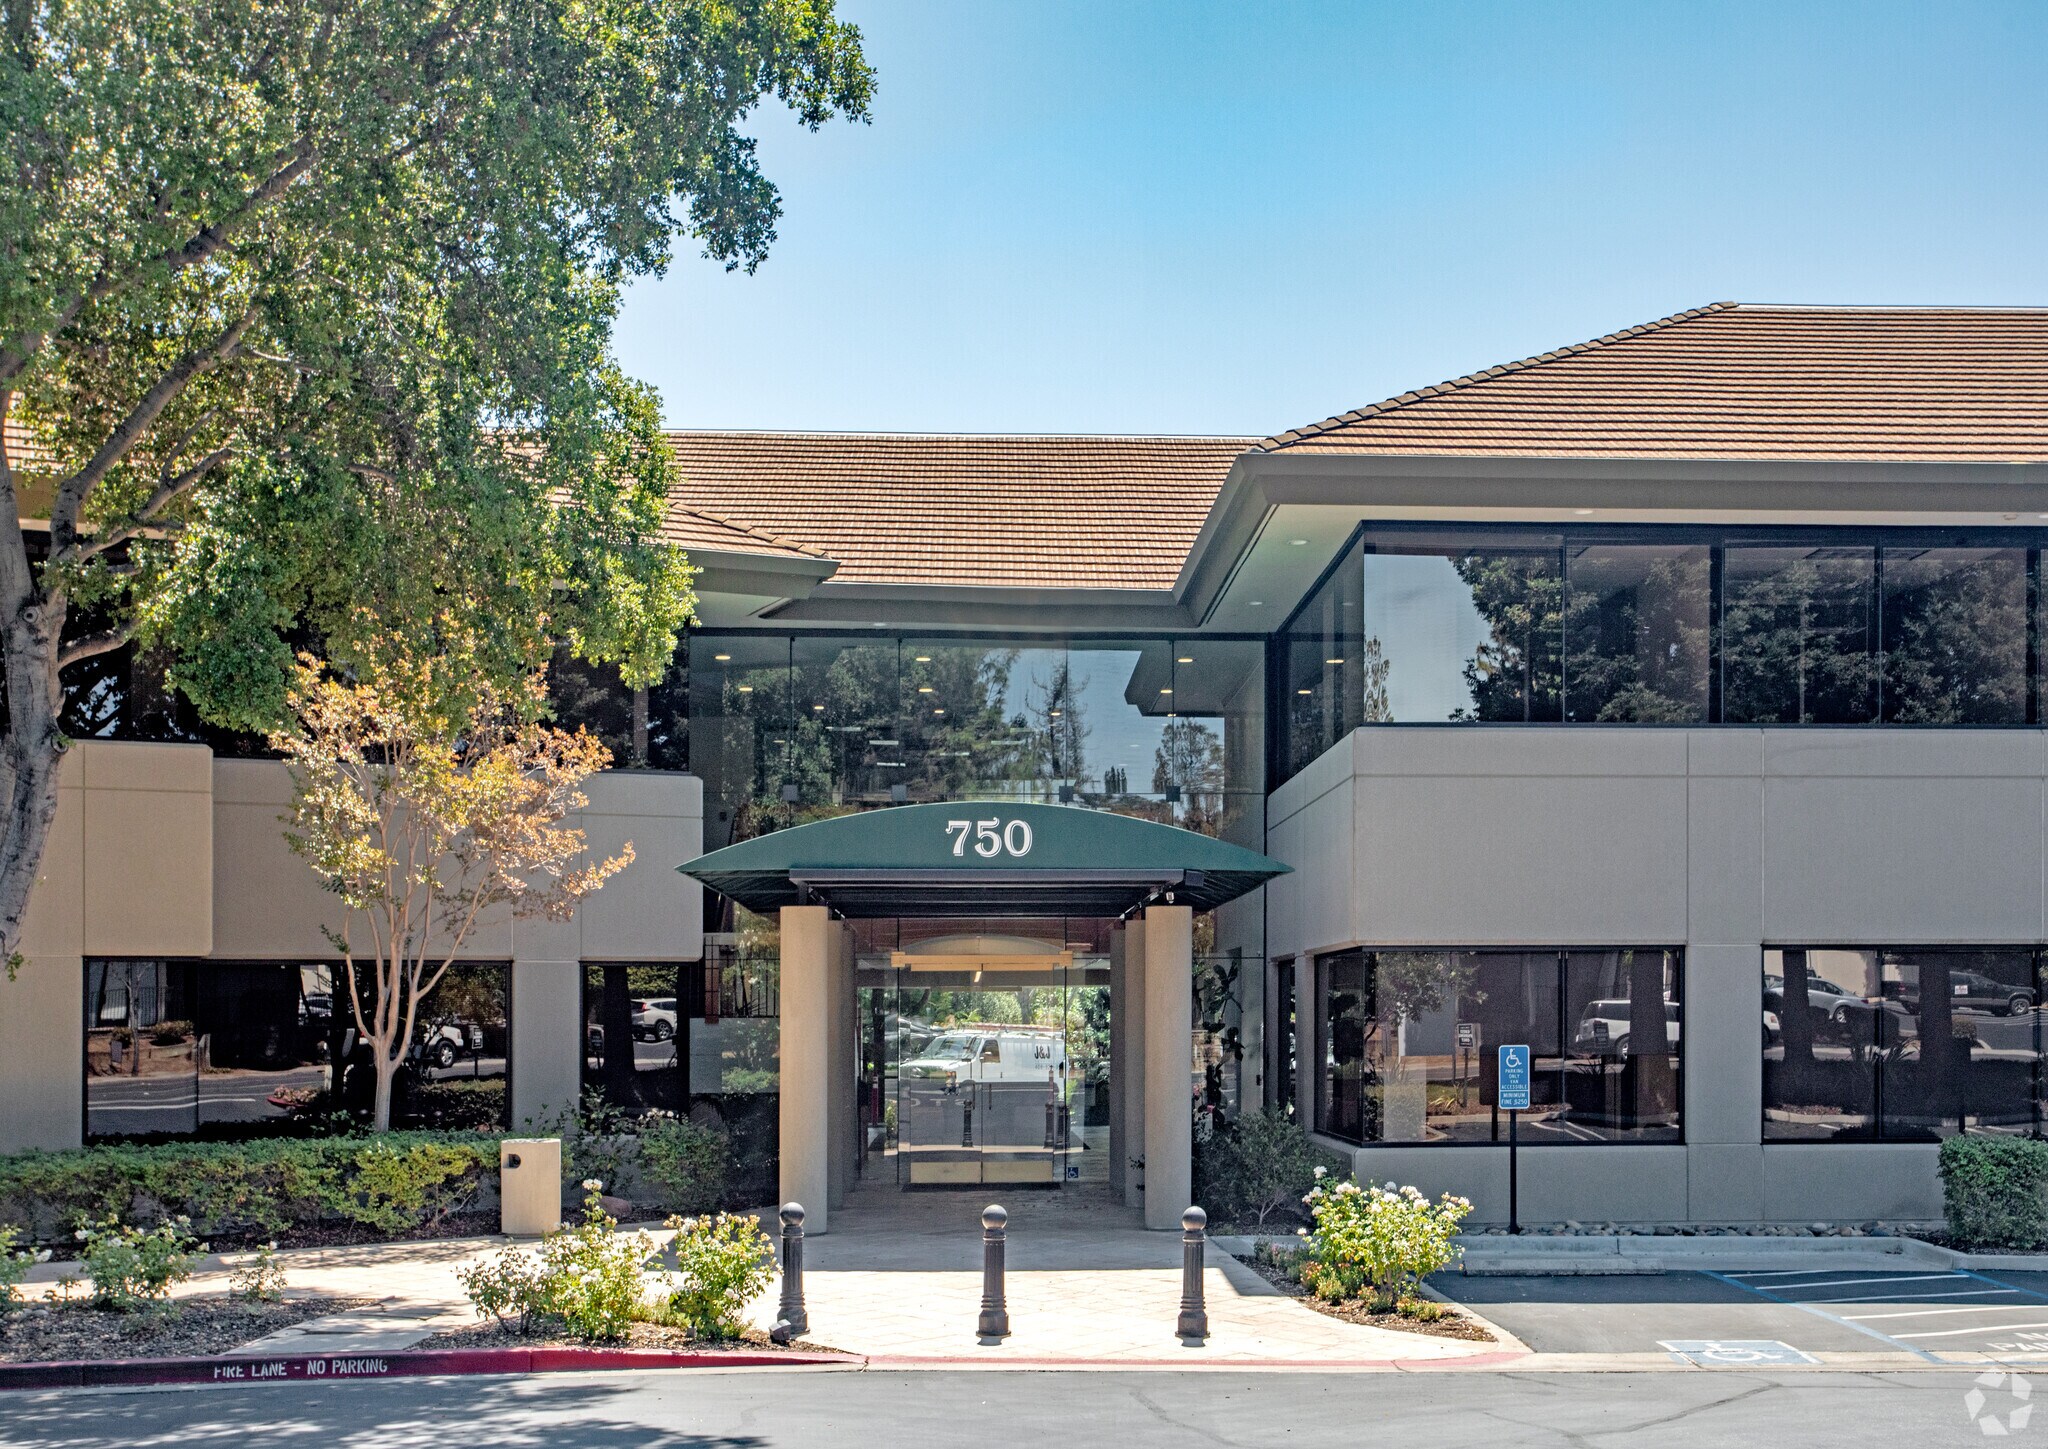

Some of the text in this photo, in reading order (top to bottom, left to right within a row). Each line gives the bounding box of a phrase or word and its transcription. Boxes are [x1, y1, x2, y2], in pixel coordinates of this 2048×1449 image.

[945, 817, 1033, 858] 750
[1034, 1046, 1051, 1060] J&J
[214, 1365, 245, 1379] FIRE
[251, 1362, 287, 1377] LANE
[307, 1360, 326, 1375] NO
[332, 1358, 388, 1374] PARKING
